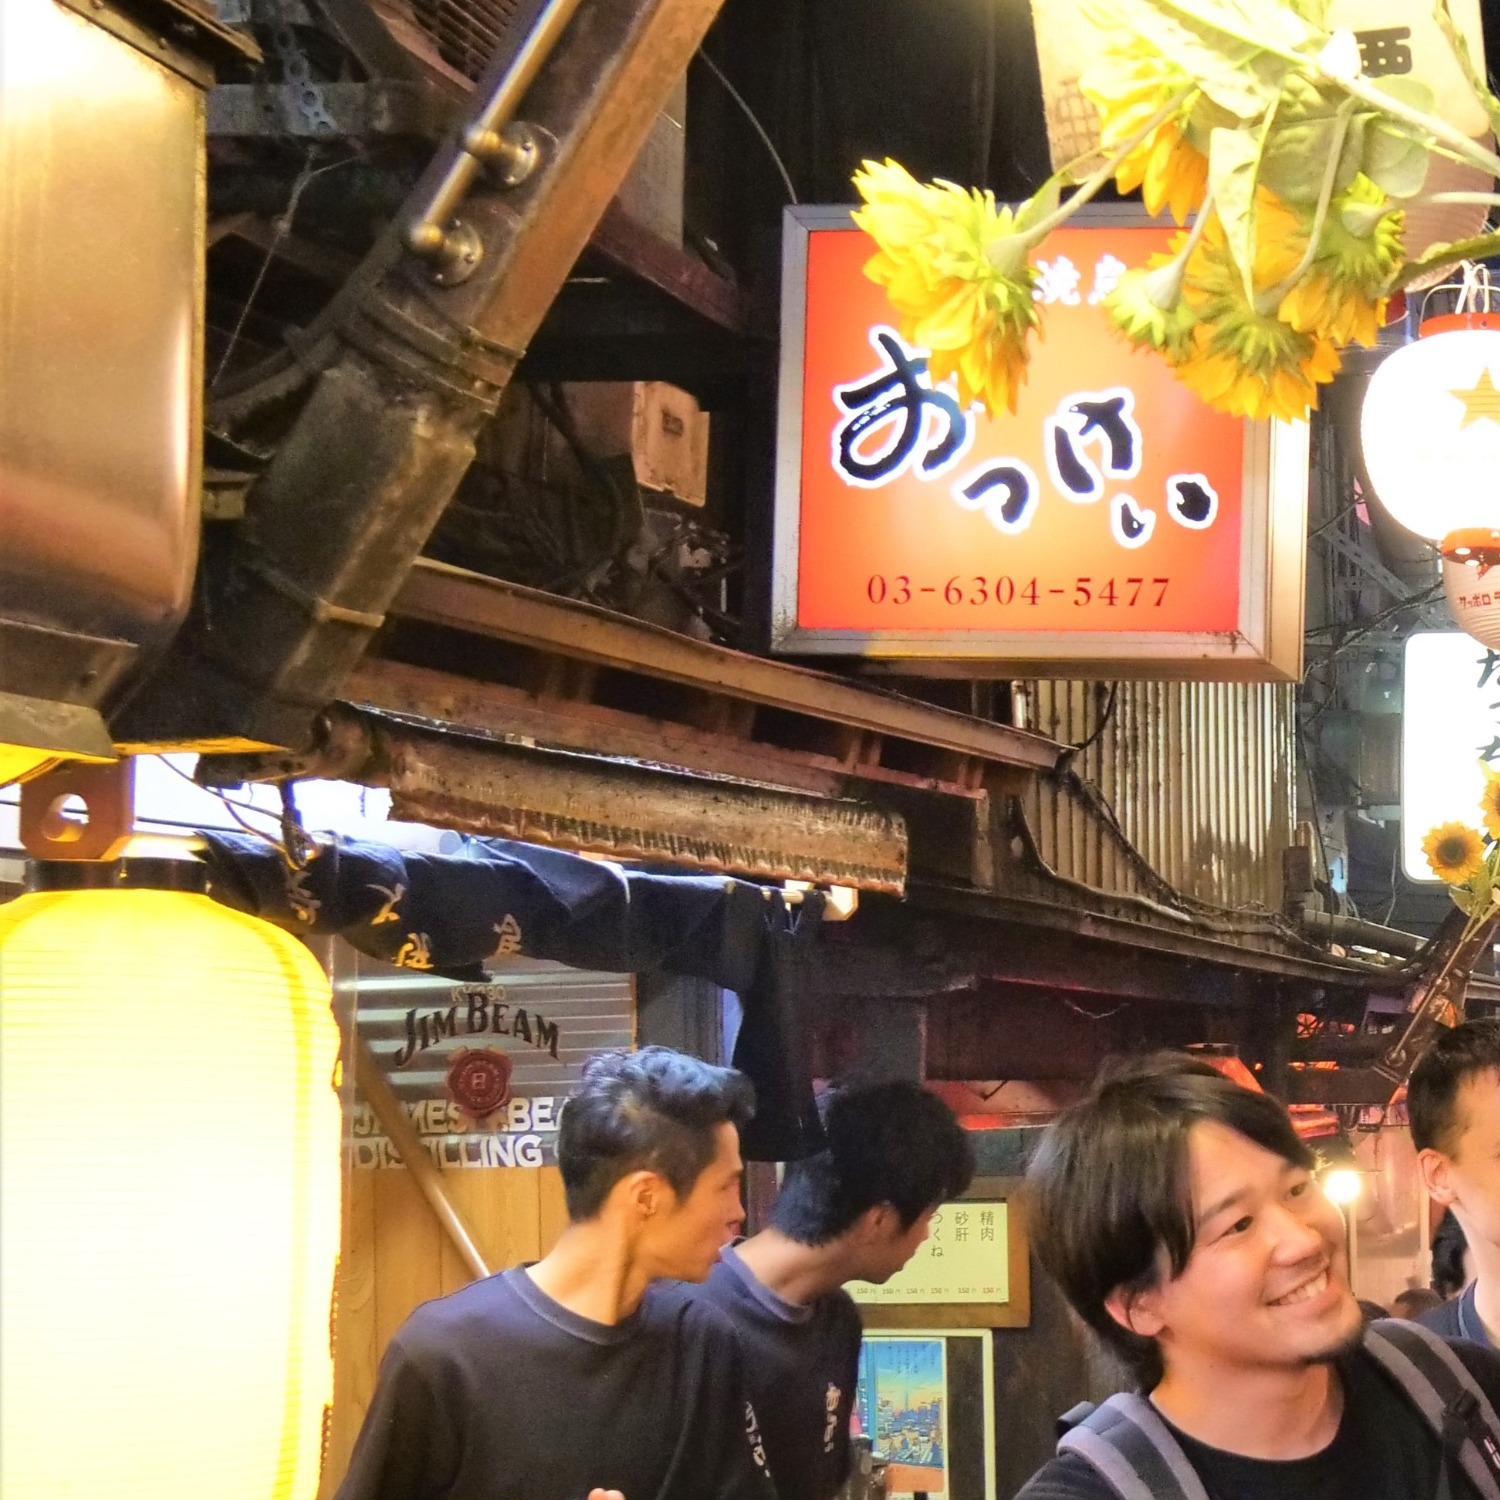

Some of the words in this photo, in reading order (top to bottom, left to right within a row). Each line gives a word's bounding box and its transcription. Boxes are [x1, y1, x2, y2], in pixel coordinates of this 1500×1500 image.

[866, 573, 1170, 608] 03-6304-5477
[394, 1004, 458, 1067] JIM
[466, 993, 560, 1061] BEAM
[351, 1134, 543, 1169] DISILLING
[955, 1211, 970, 1242] 砂肝
[980, 1210, 995, 1242] 精肉
